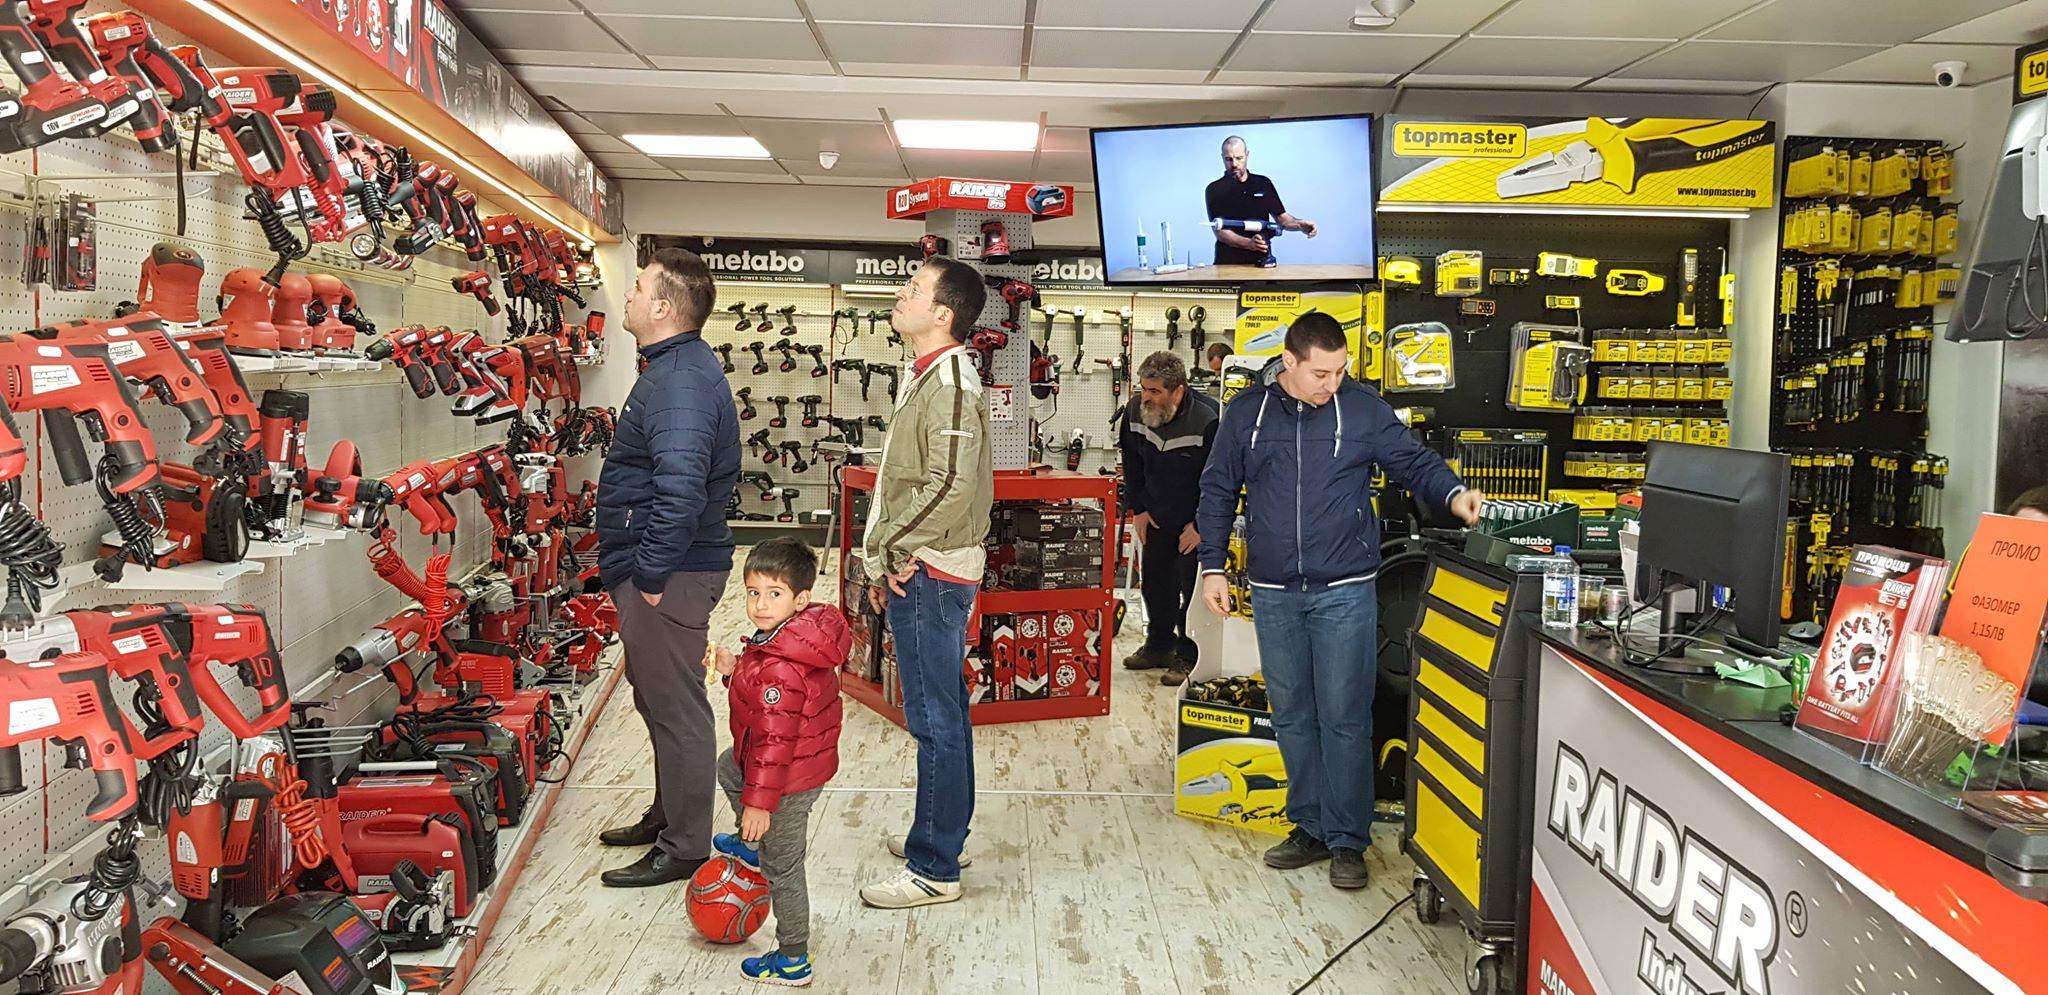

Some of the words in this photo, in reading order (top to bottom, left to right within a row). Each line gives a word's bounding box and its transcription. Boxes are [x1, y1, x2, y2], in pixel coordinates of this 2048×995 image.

[424, 0, 457, 54] RAIDER
[2029, 60, 2048, 79] to
[509, 86, 529, 119] RAIDER
[46, 121, 59, 132] 16V
[1403, 127, 1517, 147] topmaster
[1695, 132, 1765, 161] topmaster
[949, 182, 1007, 199] RAIDER
[1677, 186, 1757, 198] www.topmaster.bg
[987, 199, 1006, 209] Pro
[700, 250, 804, 273] metabo
[856, 255, 924, 276] meta
[1034, 259, 1104, 280] etab
[1245, 294, 1297, 303] topmaster
[1509, 535, 1552, 546] metabo
[1991, 540, 2041, 562] ПРОМО
[1883, 581, 1913, 597] RAIDER
[1971, 595, 2020, 615] ФАЗОМЕР
[1970, 621, 2005, 641] 1,15ЛВ
[1186, 708, 1245, 726] topmaster
[1807, 696, 1820, 706] ONE
[1819, 700, 1841, 715] BATTERY
[1840, 710, 1851, 720] FITS
[1253, 717, 1272, 727] PROF
[338, 809, 387, 820] RAIDER
[1548, 742, 1778, 995] RAIDER
[367, 878, 394, 887] RAID
